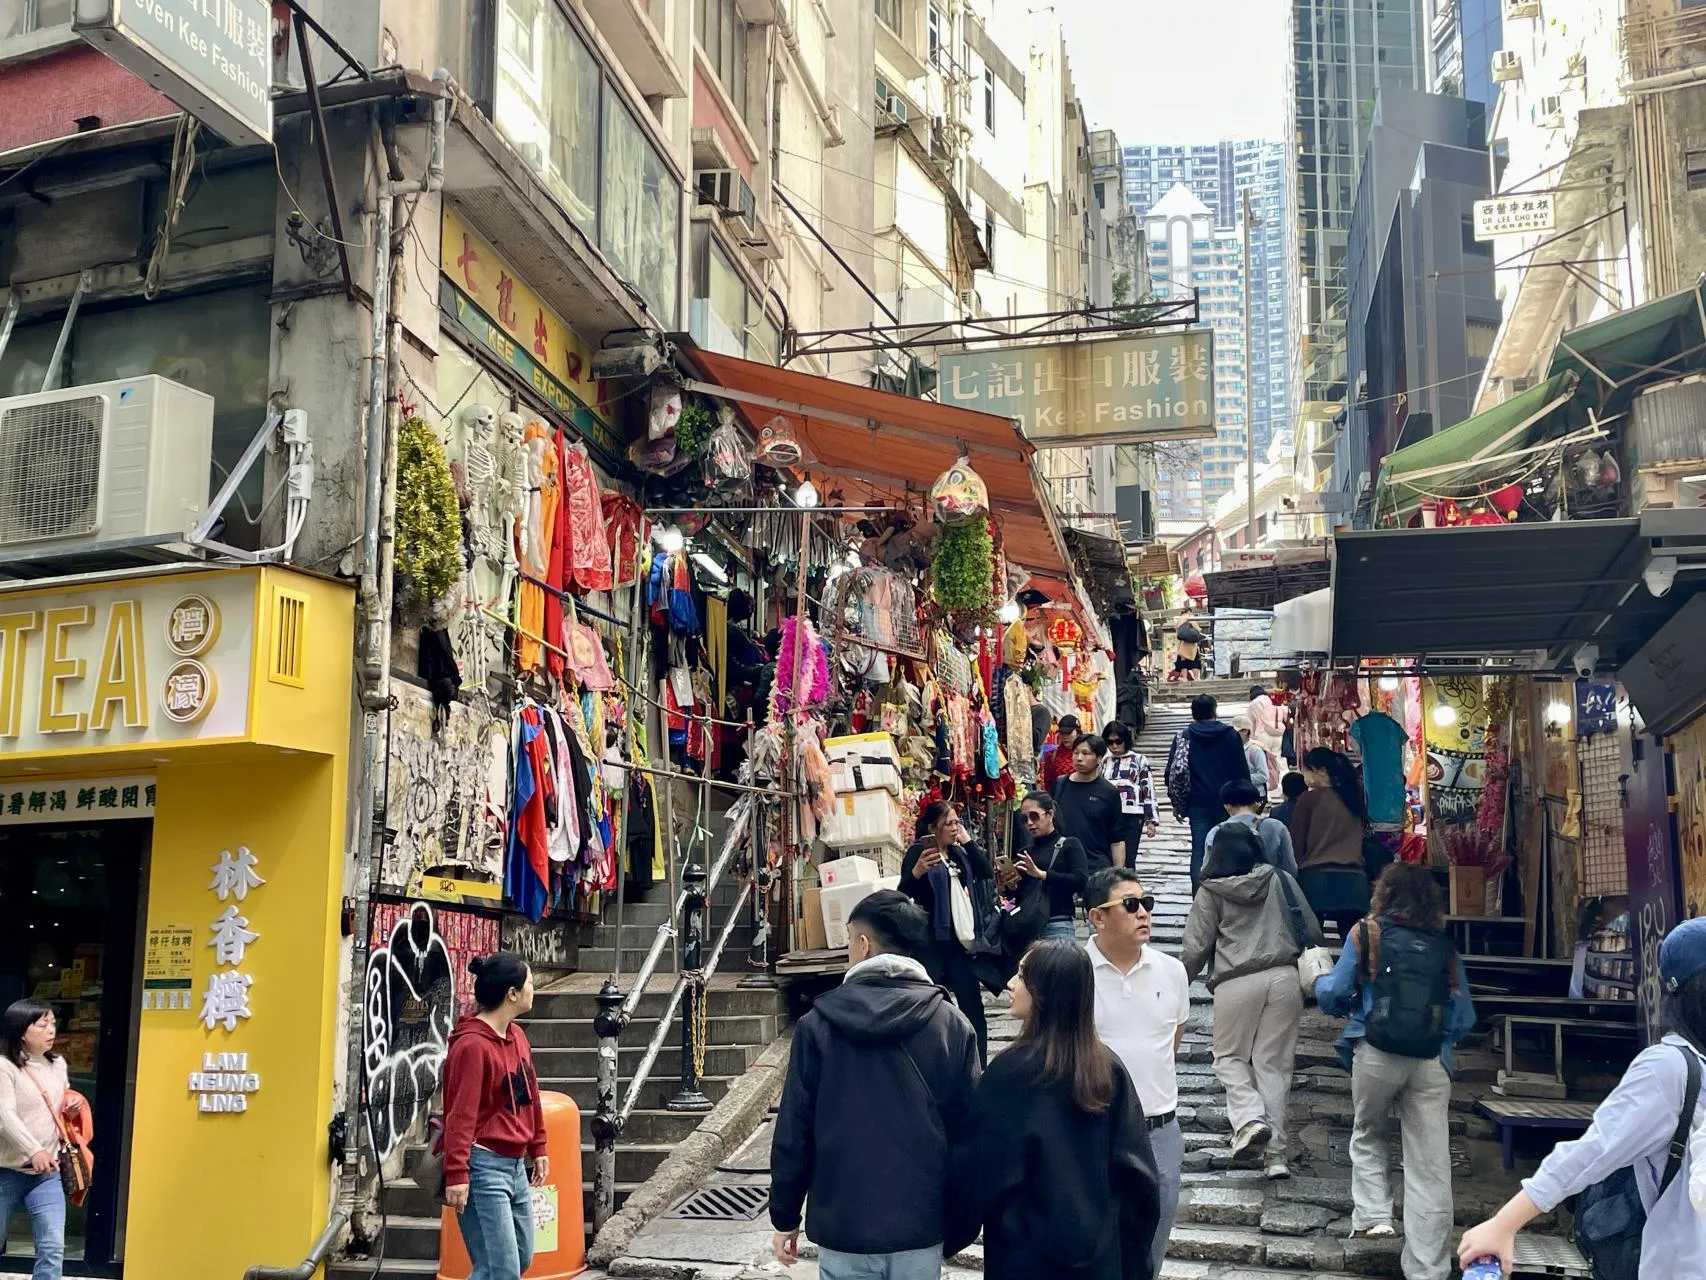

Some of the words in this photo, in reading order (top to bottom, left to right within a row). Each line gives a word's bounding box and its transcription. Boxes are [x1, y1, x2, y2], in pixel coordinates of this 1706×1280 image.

[134, 0, 174, 32] even
[178, 16, 208, 58] Kee
[212, 42, 267, 107] Fashion
[1533, 211, 1549, 219] KAY
[456, 294, 466, 317] 7
[487, 325, 514, 364] KEE
[533, 367, 577, 418] EXPORT
[943, 344, 1209, 401] 七記出口服裝
[1035, 405, 1087, 428] Kee
[1095, 397, 1208, 424] Fashion
[0, 600, 147, 738] TEA
[199, 846, 267, 1032] 林香檸
[187, 1072, 260, 1092] HEUNG
[203, 1052, 248, 1071] LAM
[199, 1093, 248, 1113] LING
